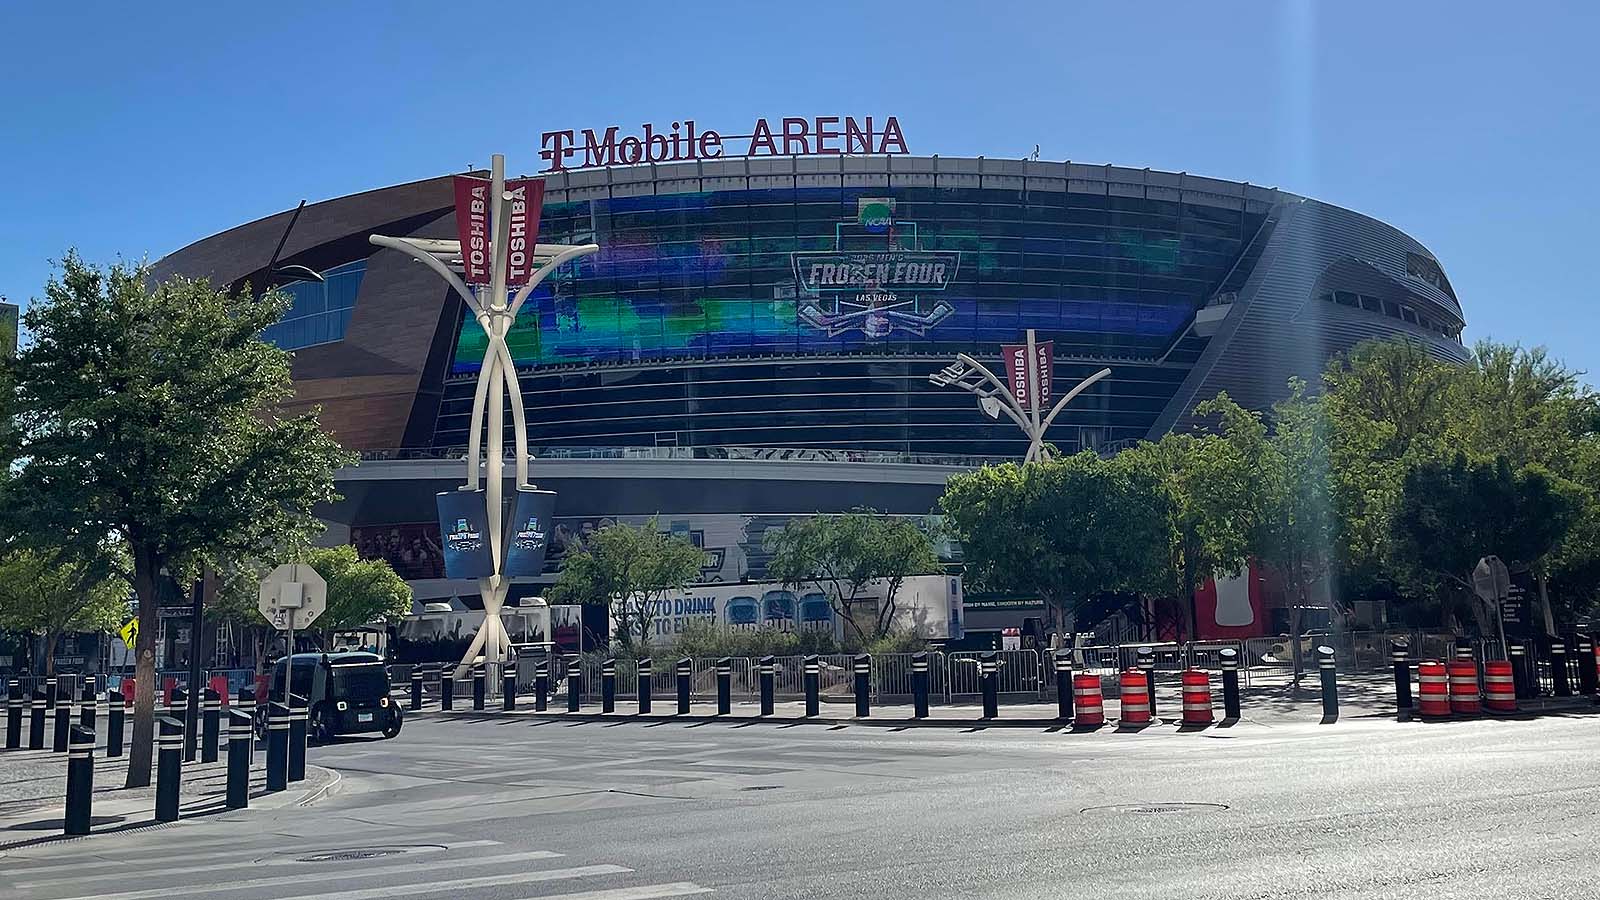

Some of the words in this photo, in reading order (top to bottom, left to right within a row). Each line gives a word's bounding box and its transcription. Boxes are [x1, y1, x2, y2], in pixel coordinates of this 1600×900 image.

[748, 117, 910, 156] ARENA
[470, 185, 486, 278] TOSHIBA
[510, 185, 526, 279] TOSHIBA
[809, 263, 890, 284] FROZEN
[893, 262, 946, 284] FOUR
[855, 294, 871, 302] LAS
[1015, 349, 1026, 404] TOSHIBA
[1039, 347, 1049, 405] TOSHIBA
[655, 599, 672, 617] TO
[674, 597, 717, 615] DRINK
